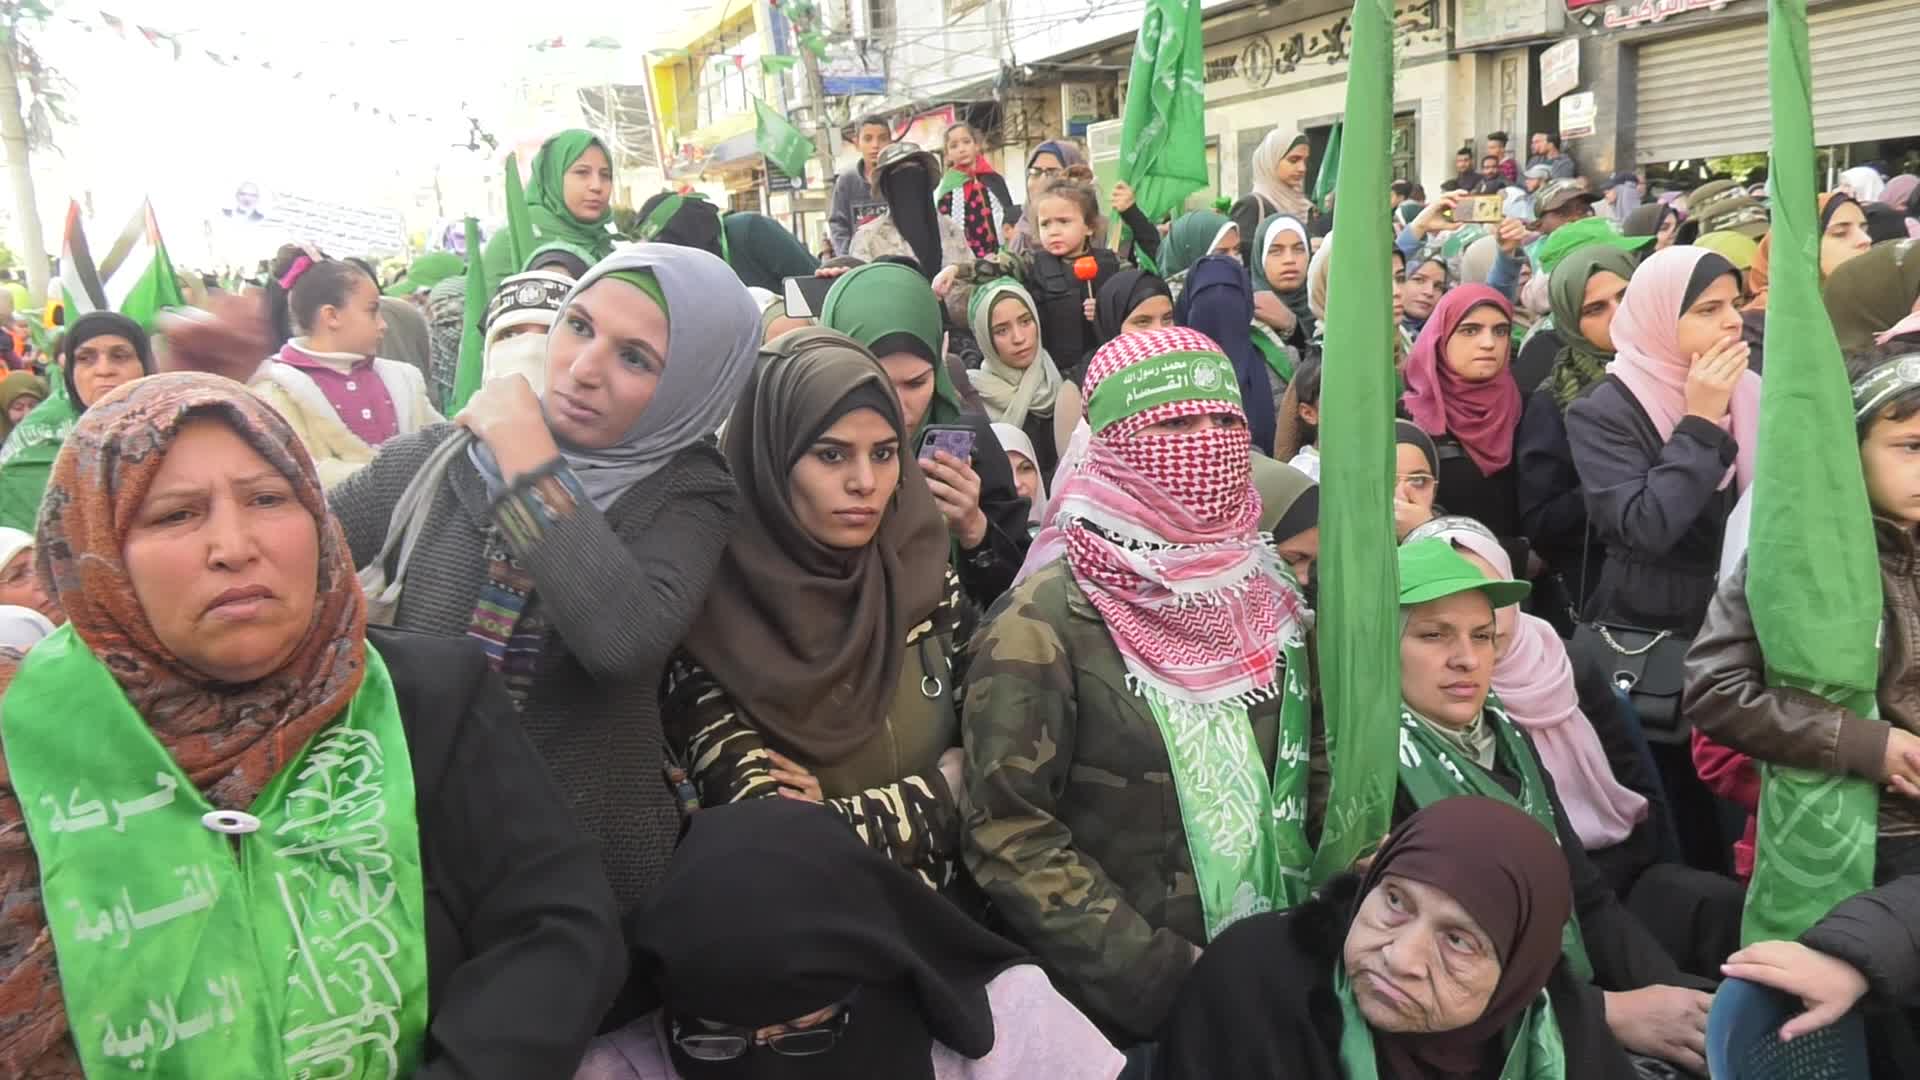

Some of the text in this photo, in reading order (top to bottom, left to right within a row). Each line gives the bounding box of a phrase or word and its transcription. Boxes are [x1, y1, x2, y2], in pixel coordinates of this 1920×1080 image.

[1123, 360, 1187, 385] محمد رسول الله
[1126, 373, 1189, 407] القسام
[40, 771, 178, 833] حركة
[64, 862, 219, 950] المقاومة
